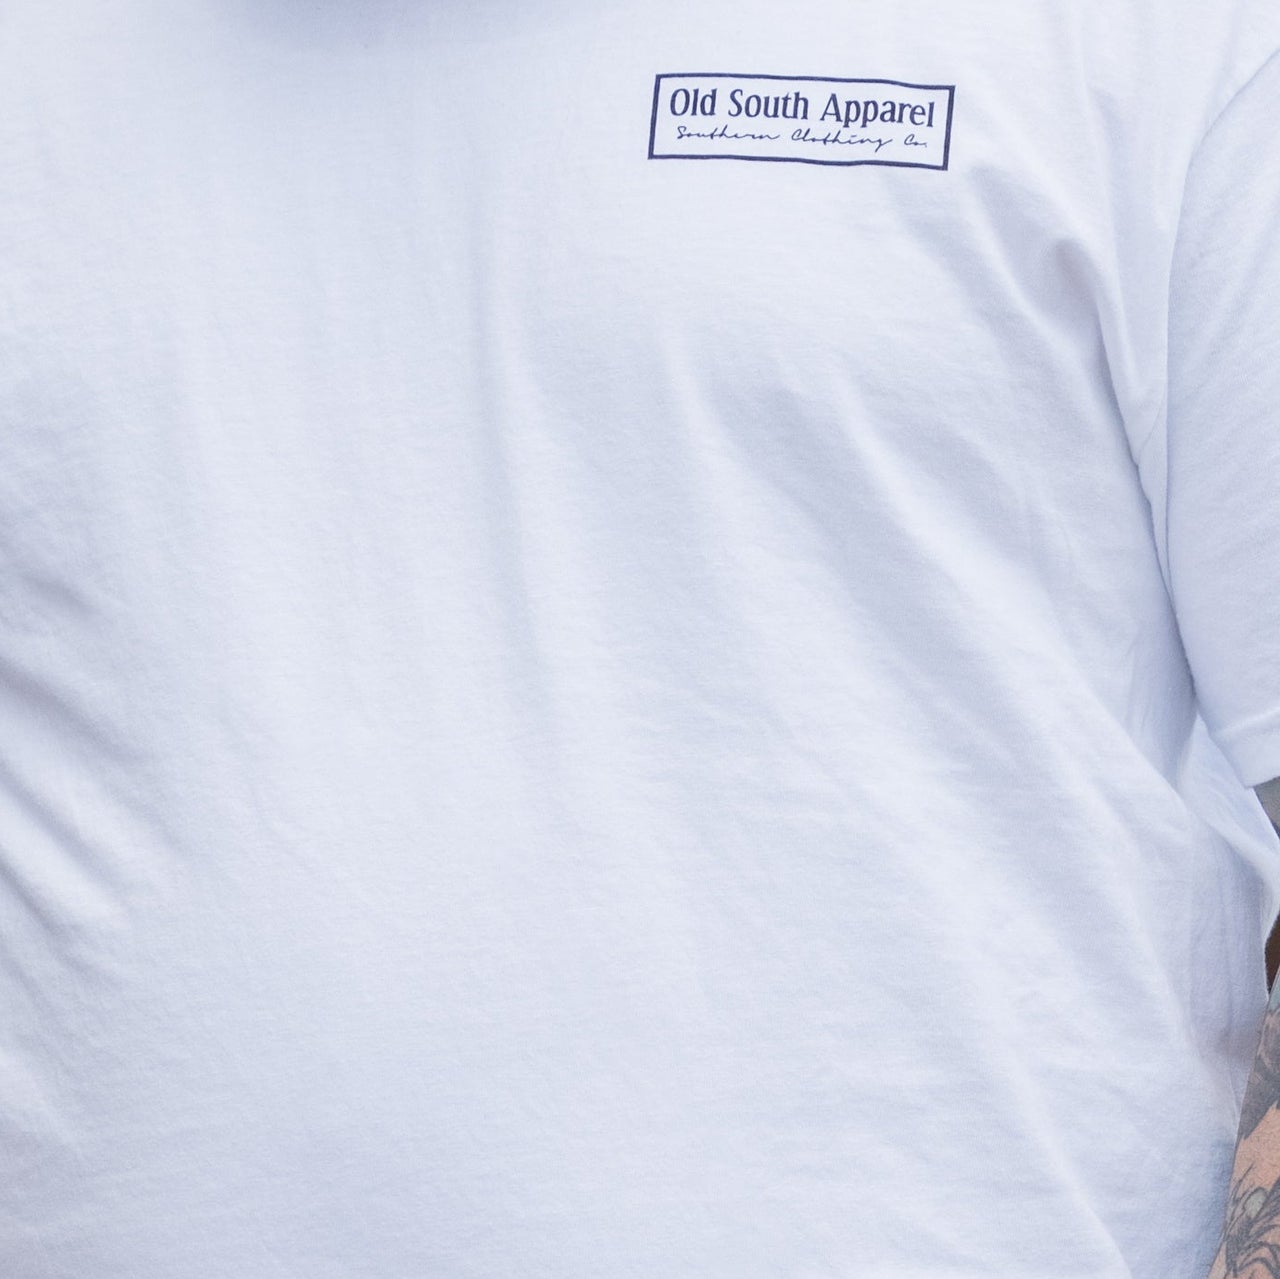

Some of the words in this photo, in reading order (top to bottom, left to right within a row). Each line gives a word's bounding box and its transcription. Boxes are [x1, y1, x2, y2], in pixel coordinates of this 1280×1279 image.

[670, 88, 718, 116] Old
[728, 88, 809, 120] South
[819, 93, 935, 128] Apparel
[677, 124, 780, 140] Southern
[791, 128, 893, 152] Clothing
